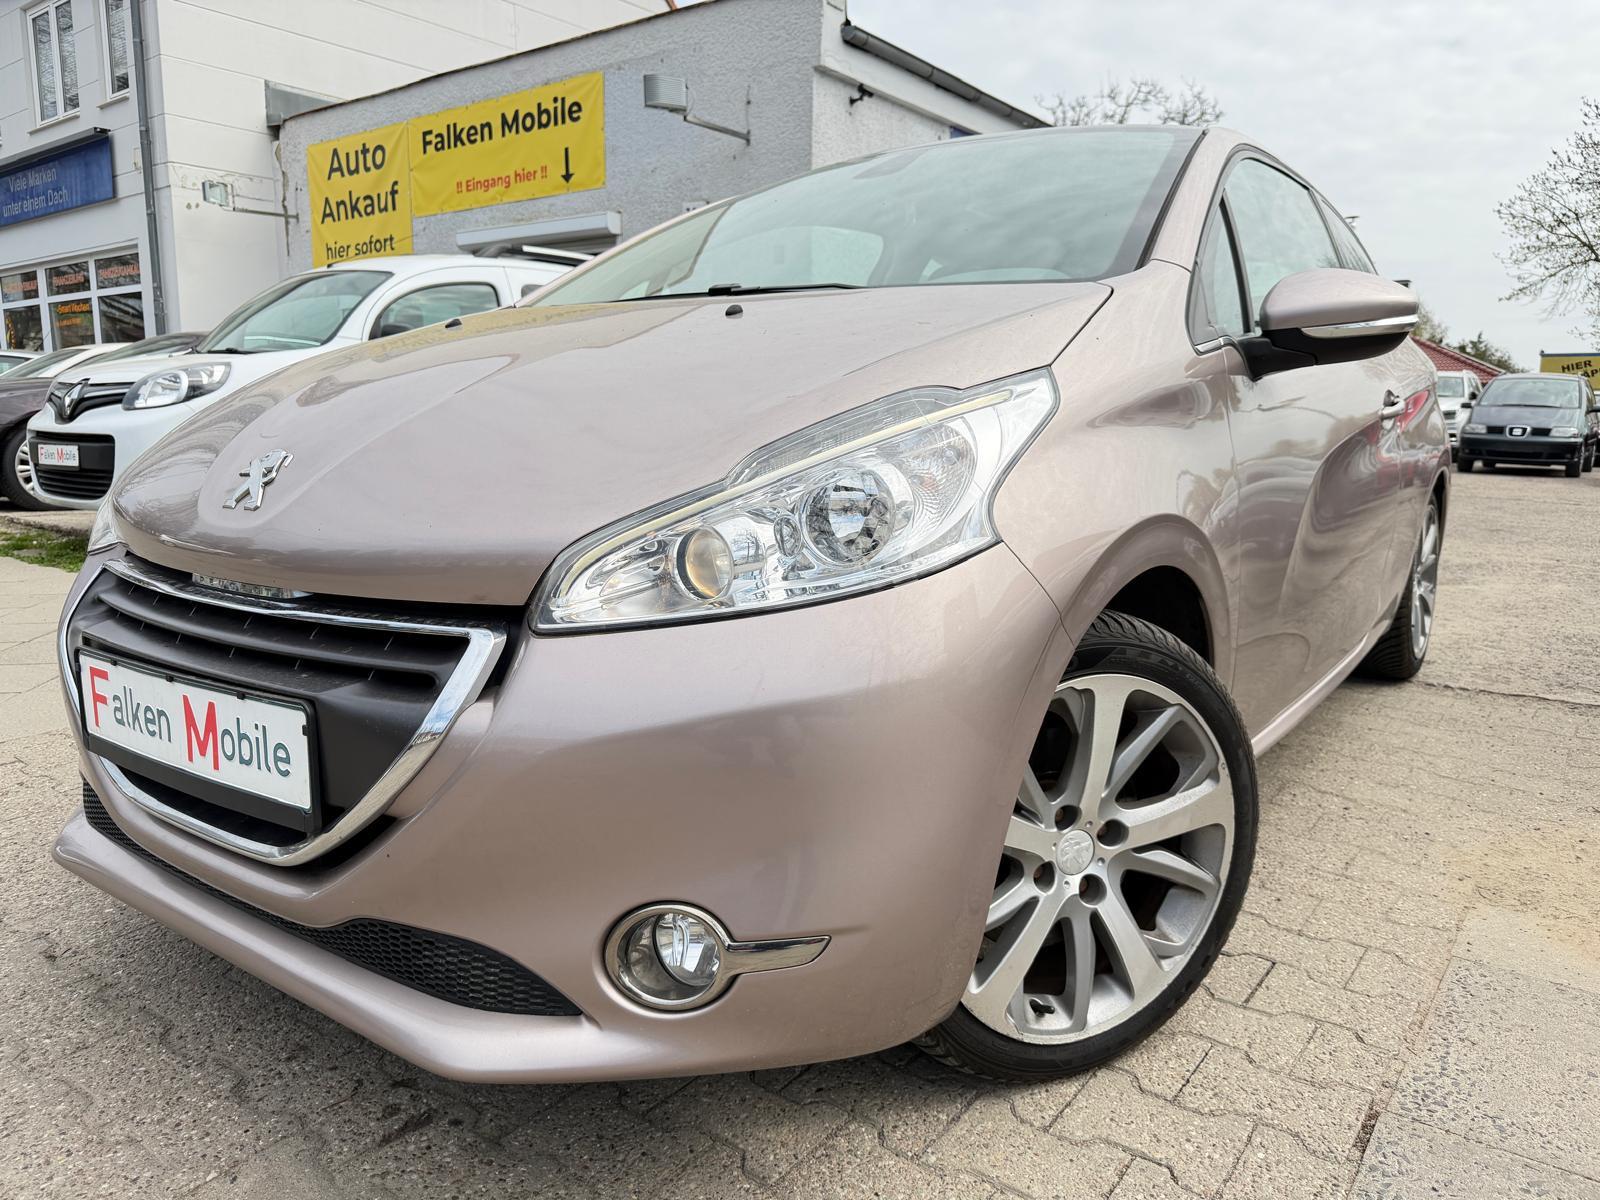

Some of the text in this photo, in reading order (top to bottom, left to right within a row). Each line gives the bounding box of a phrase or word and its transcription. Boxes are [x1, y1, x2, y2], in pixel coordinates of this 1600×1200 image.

[421, 97, 583, 155] Falken Mobile
[327, 142, 386, 181] Auto
[8, 168, 57, 192] Viele Marken
[466, 174, 511, 193] Eingang
[514, 167, 537, 183] hier
[3, 186, 69, 217] unter einem Dach
[320, 181, 399, 224] Ankauf
[326, 234, 395, 260] hier sofort
[1561, 360, 1592, 373] HIER
[89, 666, 291, 777] Falken Mobile
